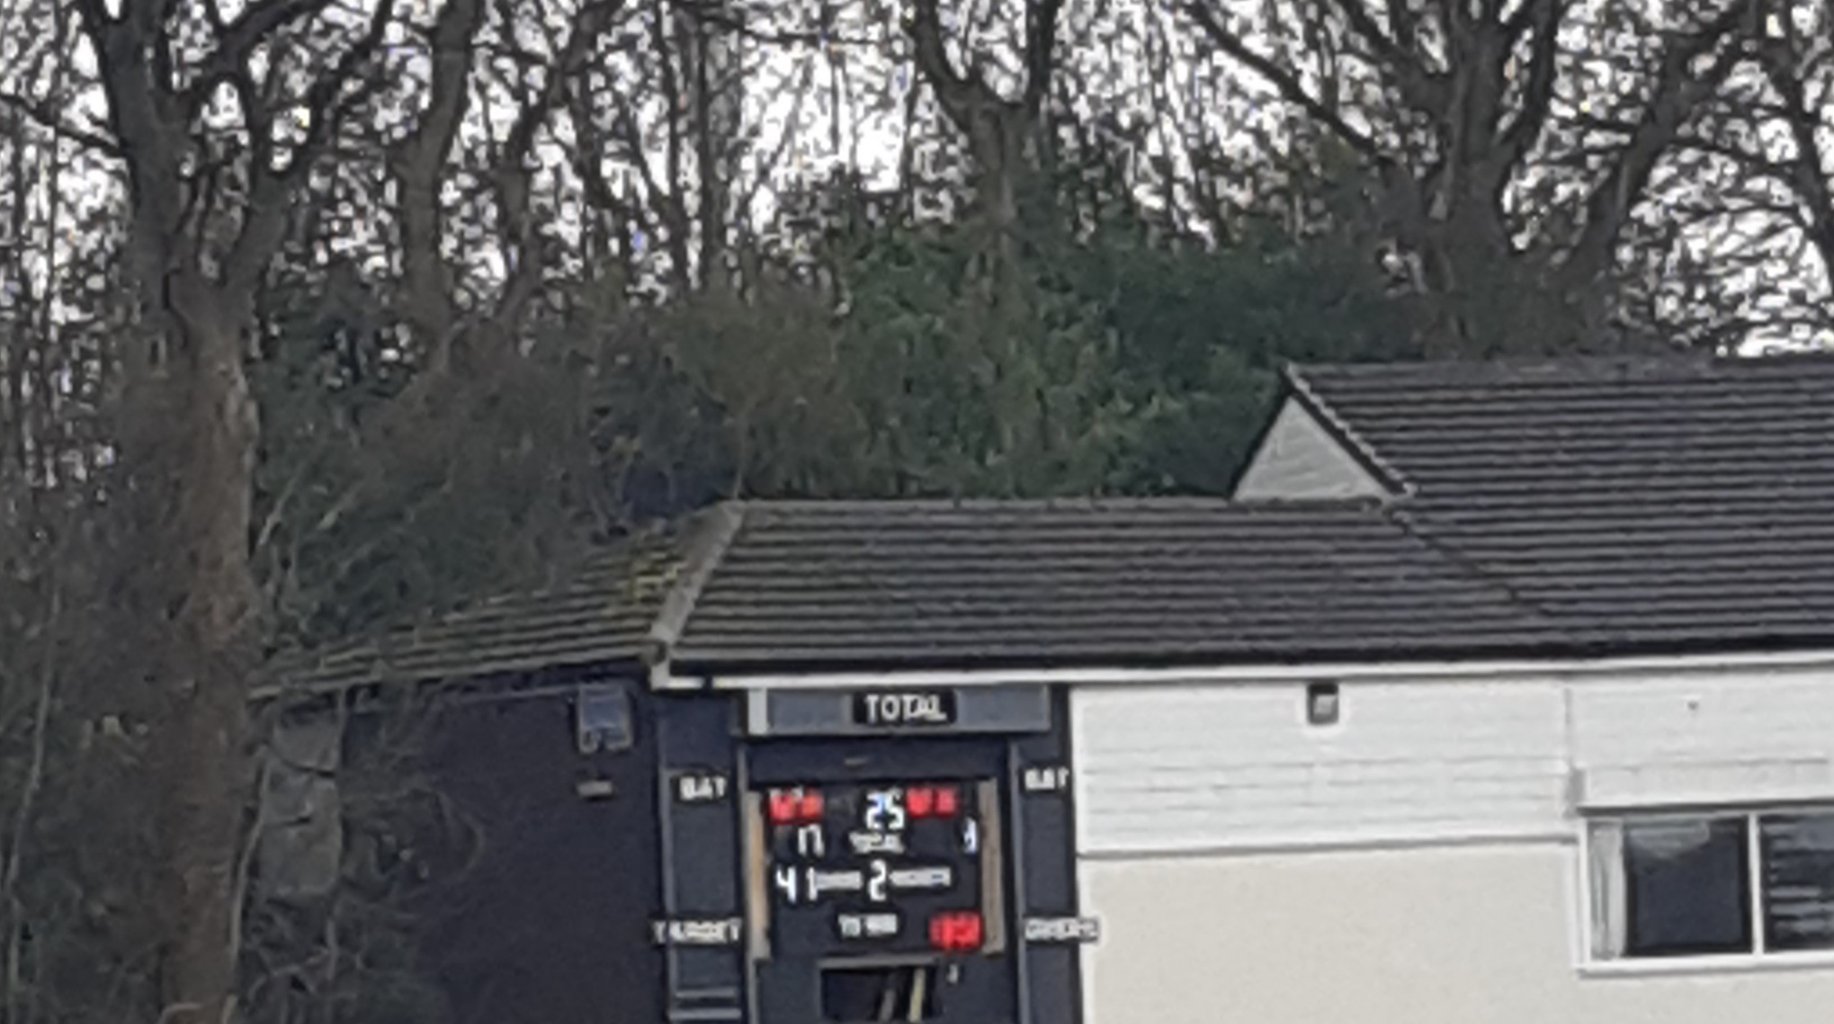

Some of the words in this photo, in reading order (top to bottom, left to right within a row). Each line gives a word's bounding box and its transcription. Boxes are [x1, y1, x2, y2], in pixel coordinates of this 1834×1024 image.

[865, 694, 947, 723] TOTAL
[680, 776, 727, 800] BAT
[865, 788, 905, 830] 25
[868, 859, 887, 901] 2
